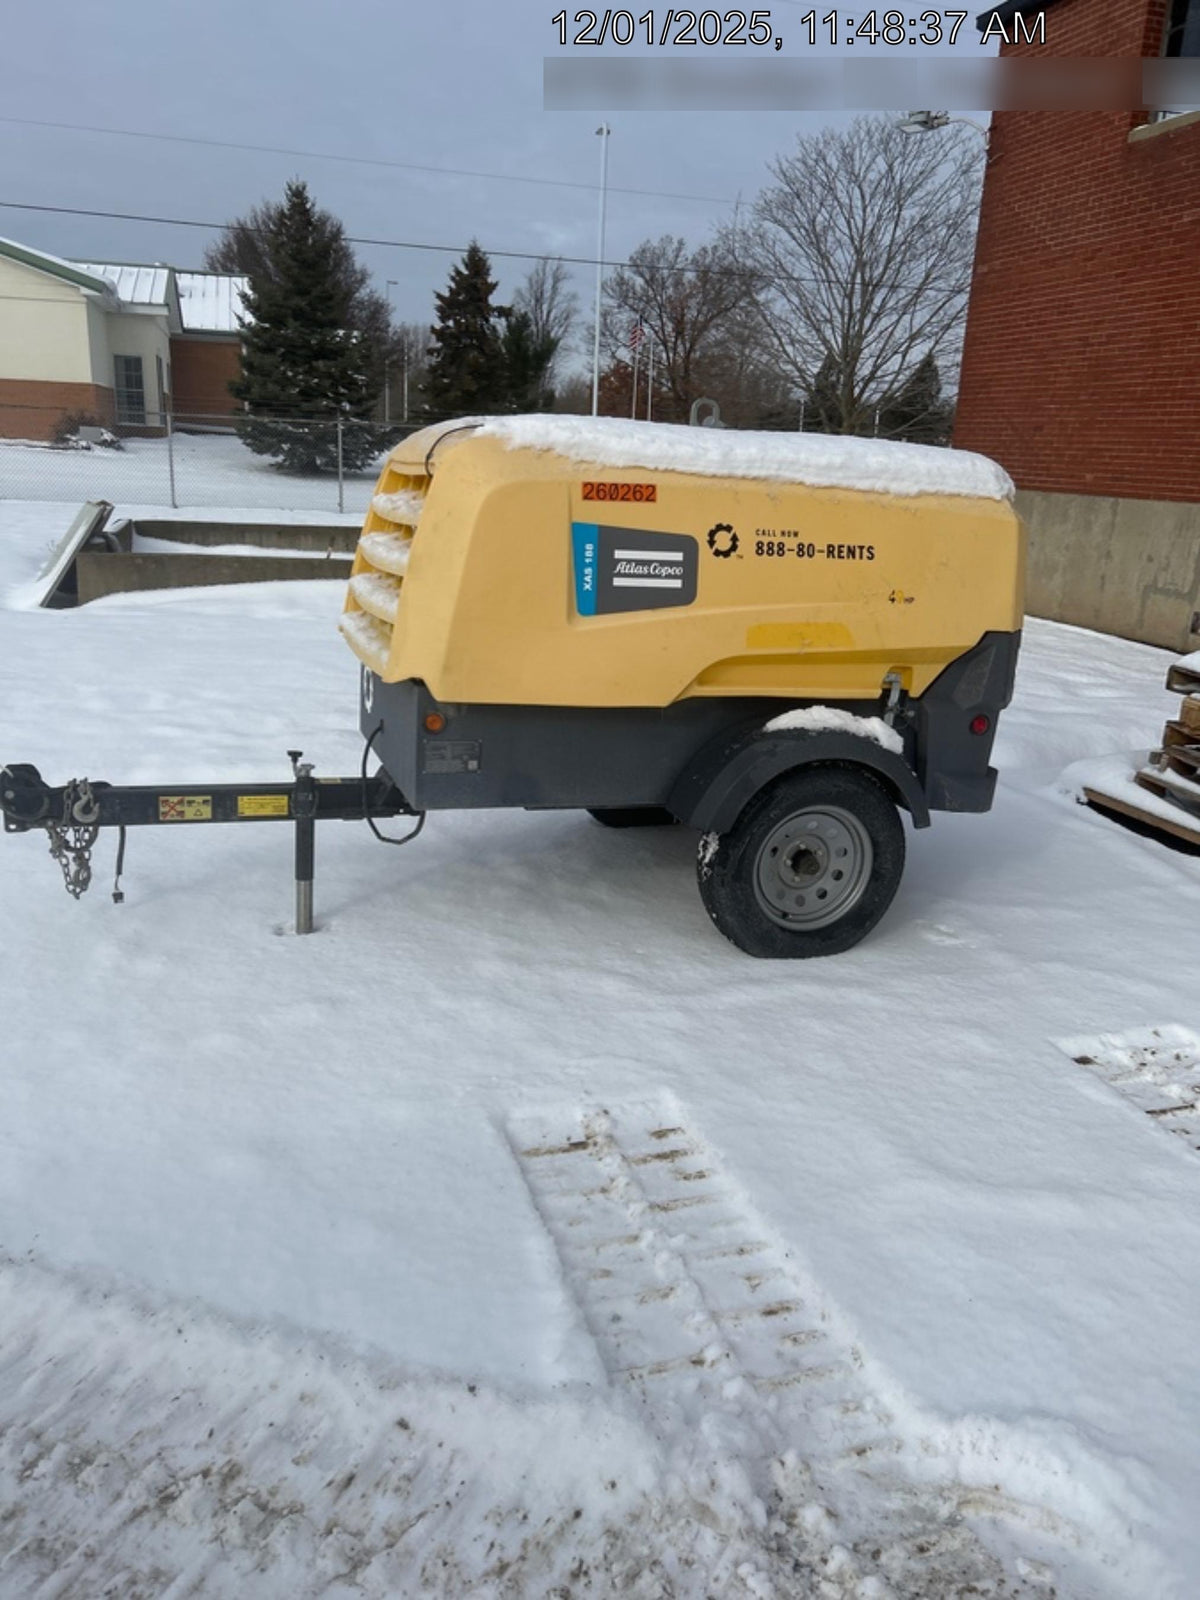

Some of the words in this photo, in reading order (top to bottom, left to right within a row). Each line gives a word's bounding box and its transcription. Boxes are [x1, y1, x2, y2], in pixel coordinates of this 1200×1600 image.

[583, 482, 656, 502] 260262
[755, 528, 777, 538] CALL
[780, 530, 799, 538] NOW
[755, 540, 875, 561] 888-80-RENTS
[583, 567, 593, 591] XAS
[614, 561, 649, 575] Atlas
[650, 562, 684, 577] Copco
